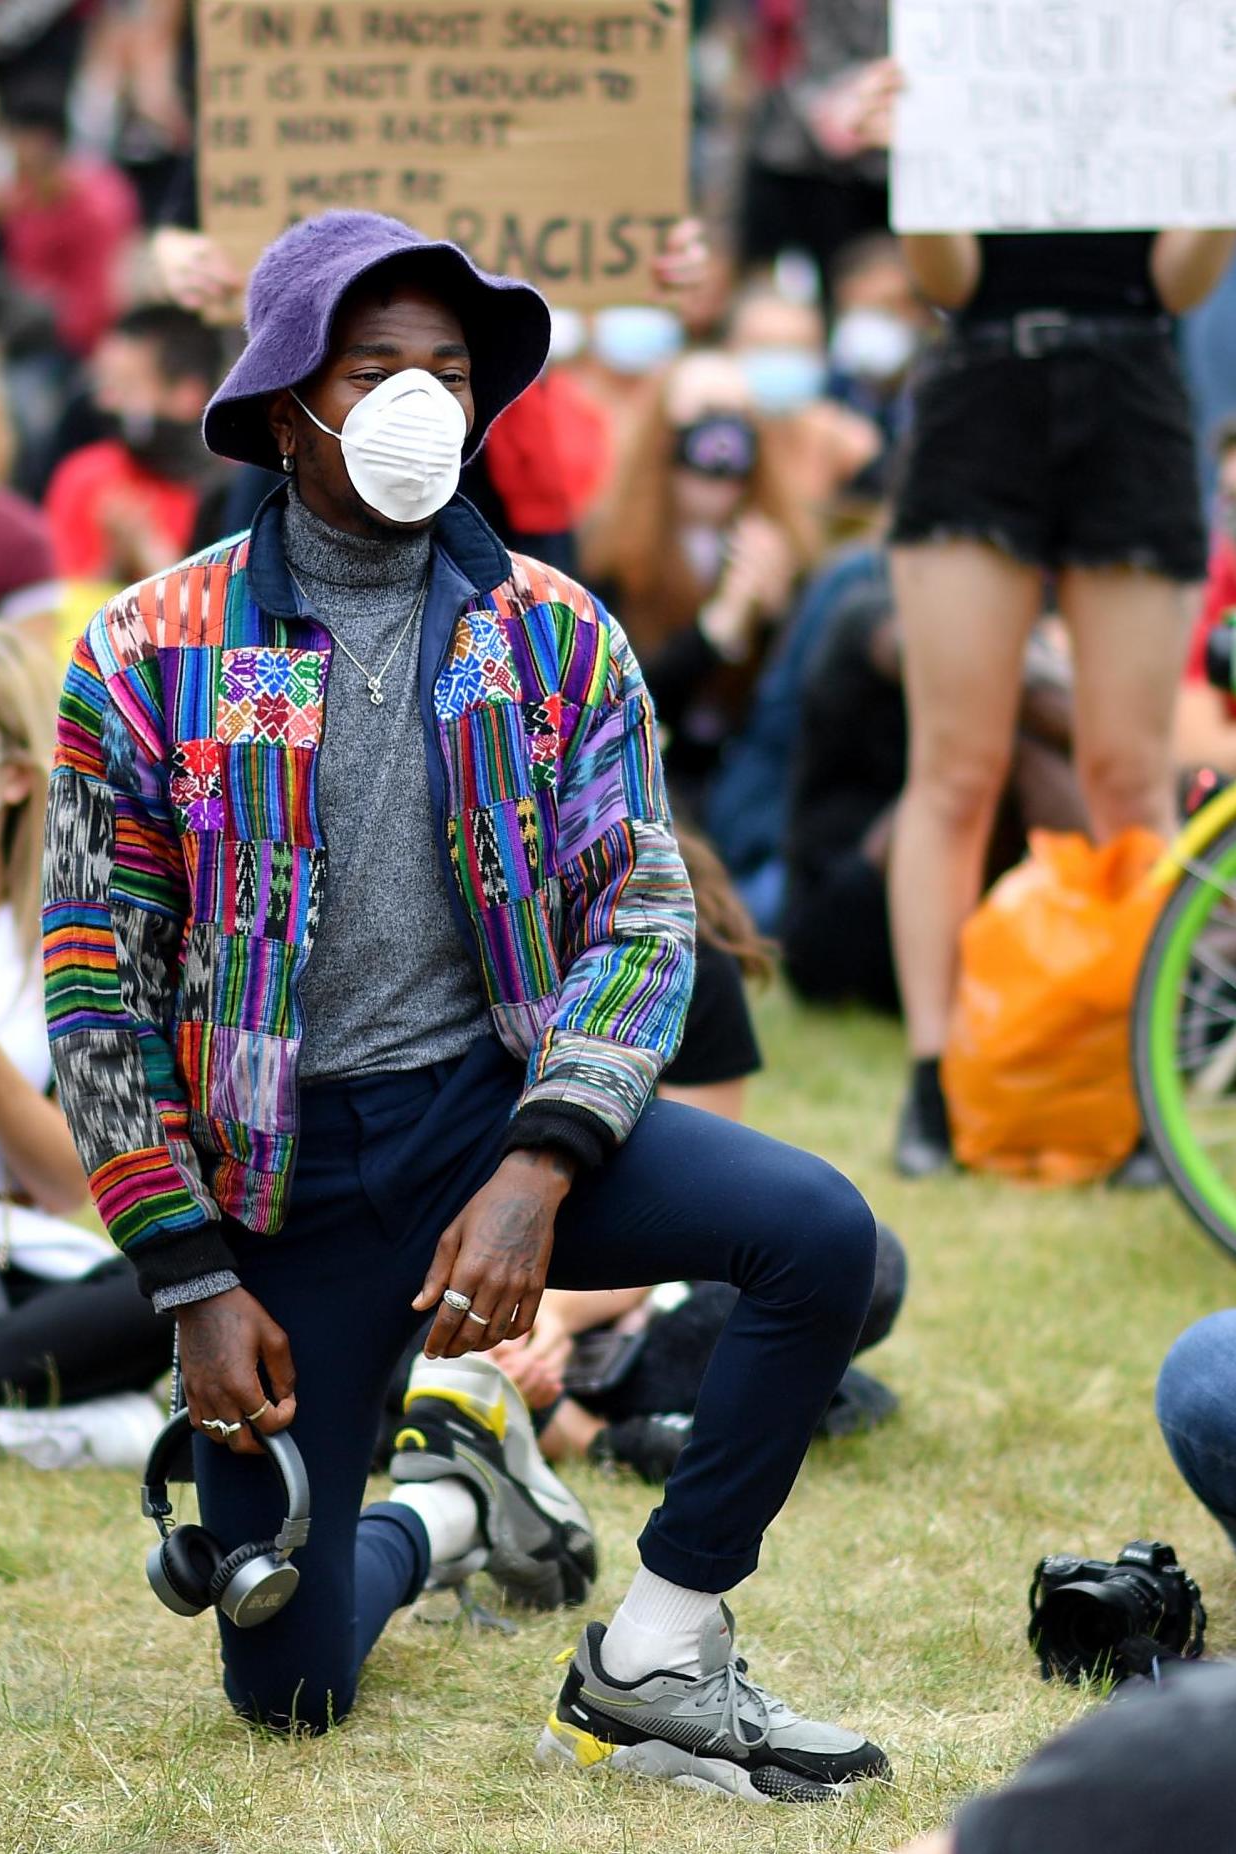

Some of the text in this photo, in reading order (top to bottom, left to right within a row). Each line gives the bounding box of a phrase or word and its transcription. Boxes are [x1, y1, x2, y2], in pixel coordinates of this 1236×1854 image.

[311, 5, 344, 47] A
[324, 63, 412, 100] NOT
[428, 65, 583, 103] ENOUGH
[286, 168, 382, 203] MUST
